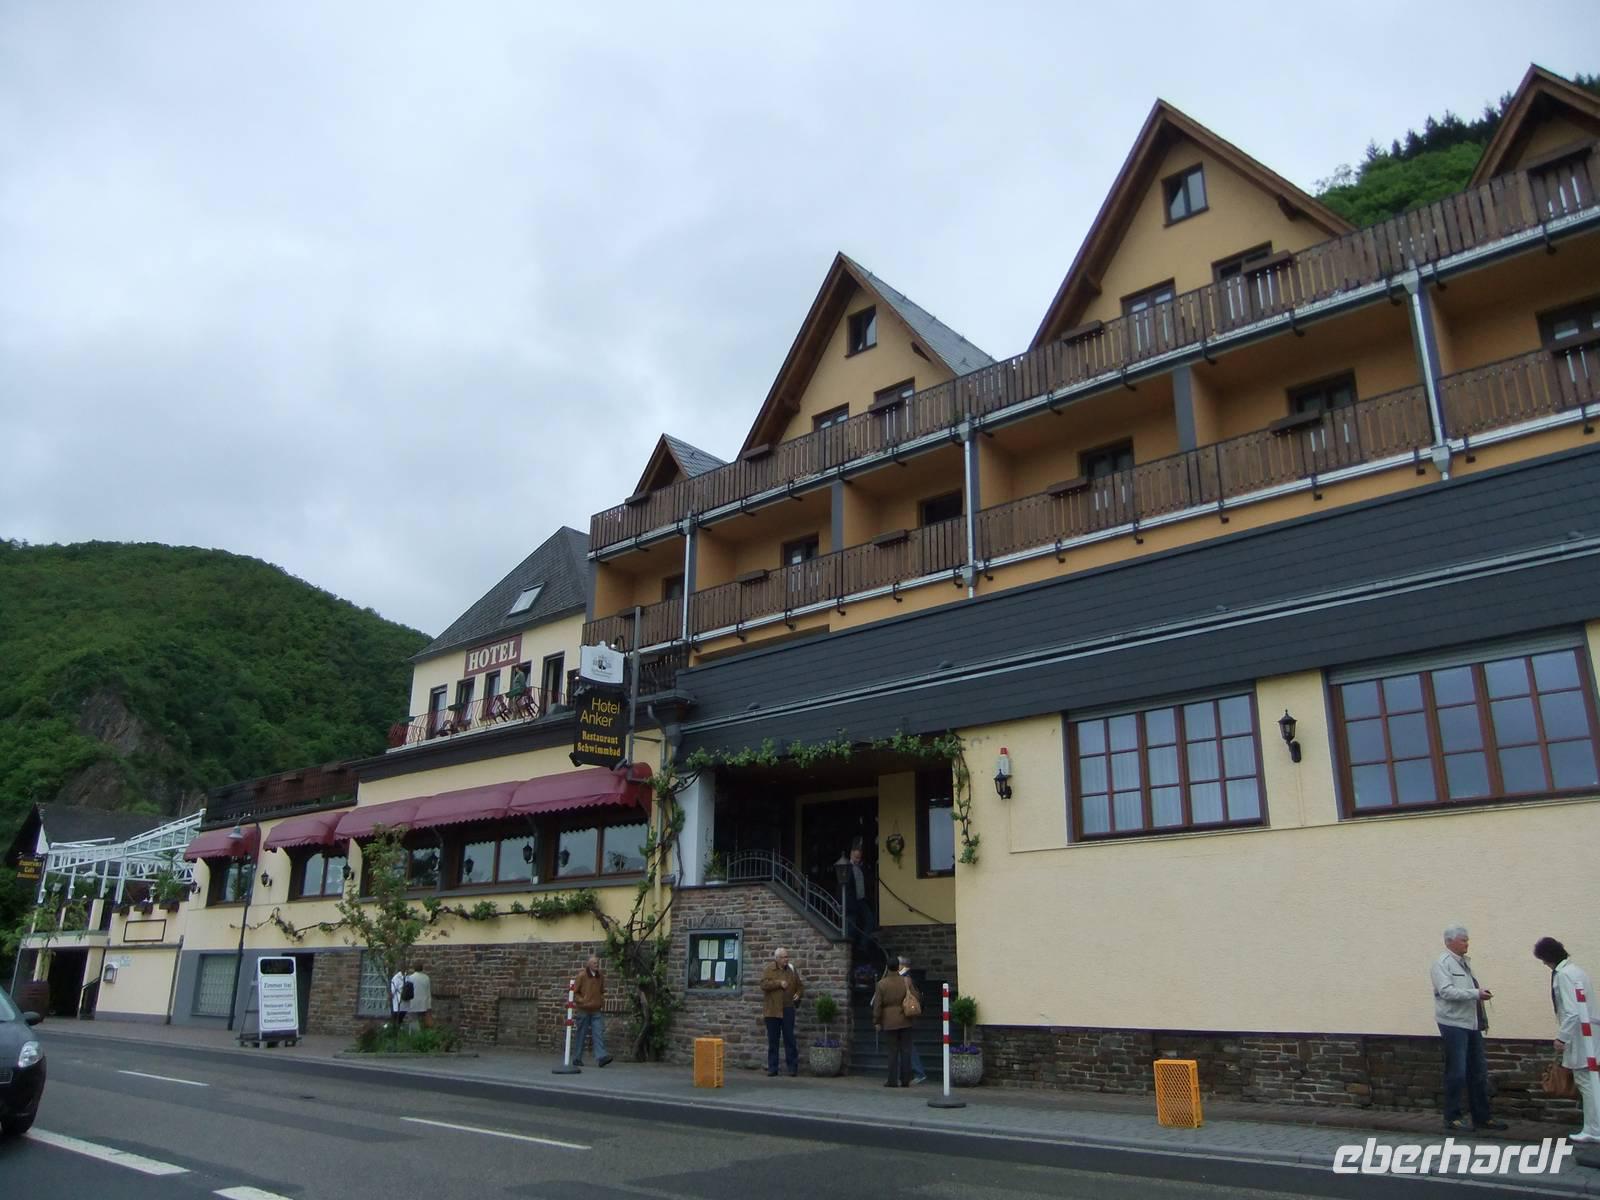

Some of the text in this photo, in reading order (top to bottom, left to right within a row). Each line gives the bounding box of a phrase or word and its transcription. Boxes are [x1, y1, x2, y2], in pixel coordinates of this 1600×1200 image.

[468, 640, 517, 671] HOTEL
[591, 697, 621, 715] Hotel
[580, 710, 613, 728] Anker
[582, 731, 618, 745] Restaurant
[577, 742, 621, 757] Schwimmbad
